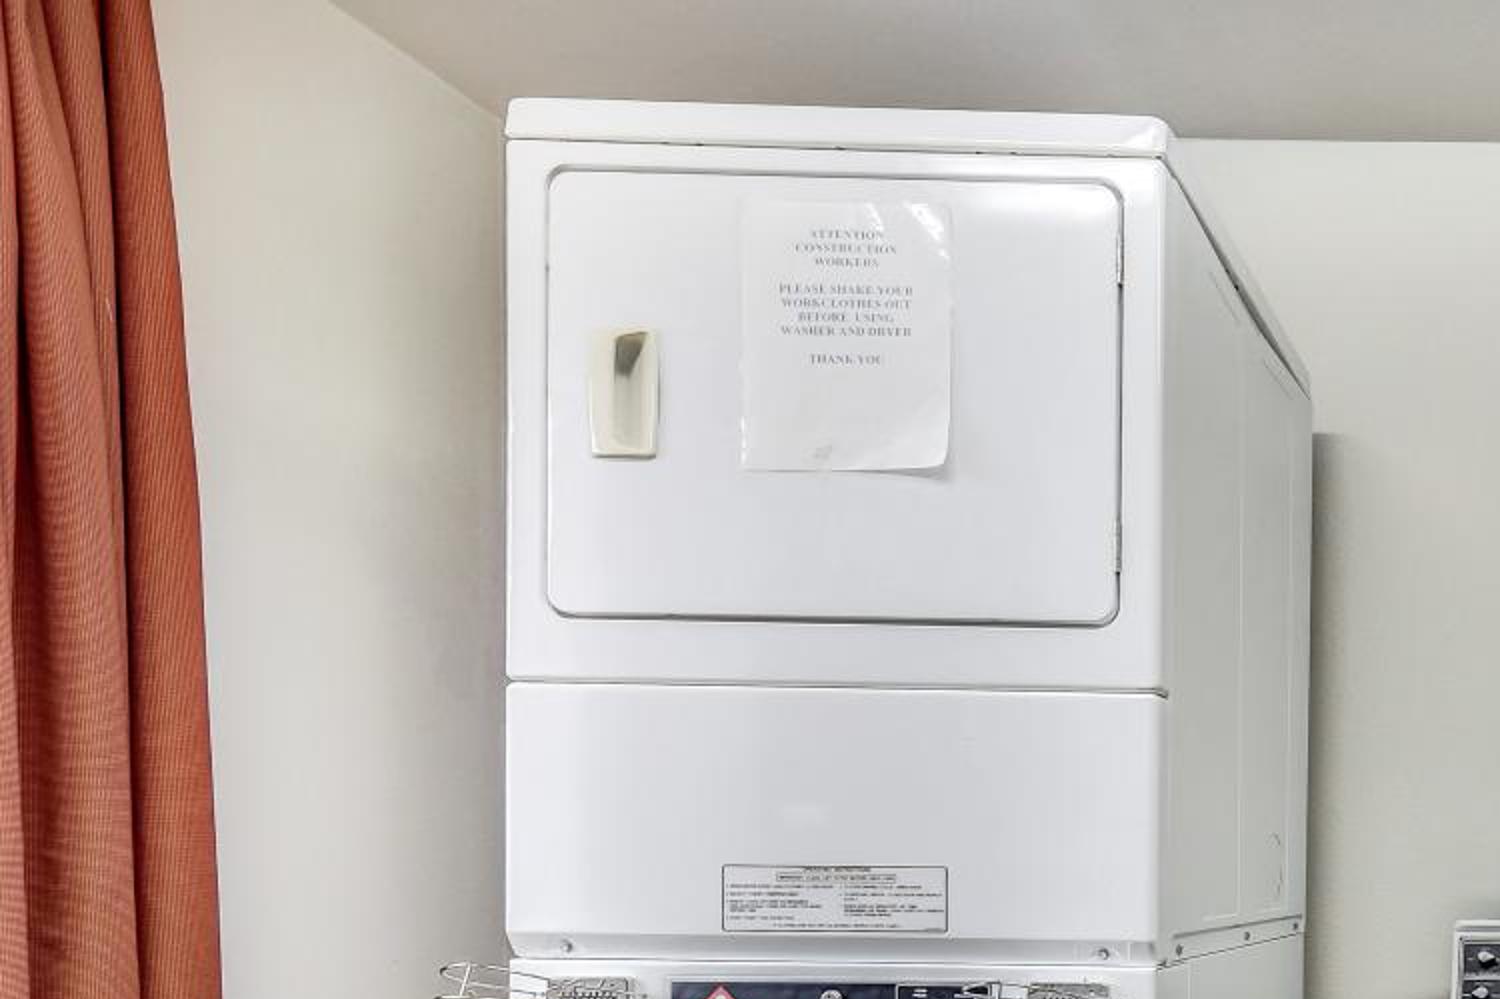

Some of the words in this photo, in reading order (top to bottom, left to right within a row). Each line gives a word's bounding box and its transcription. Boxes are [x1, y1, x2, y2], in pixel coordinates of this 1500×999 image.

[779, 283, 826, 295] PLEASE
[780, 325, 835, 337] WASHER
[839, 326, 865, 337] AND
[810, 353, 853, 365] THANK
